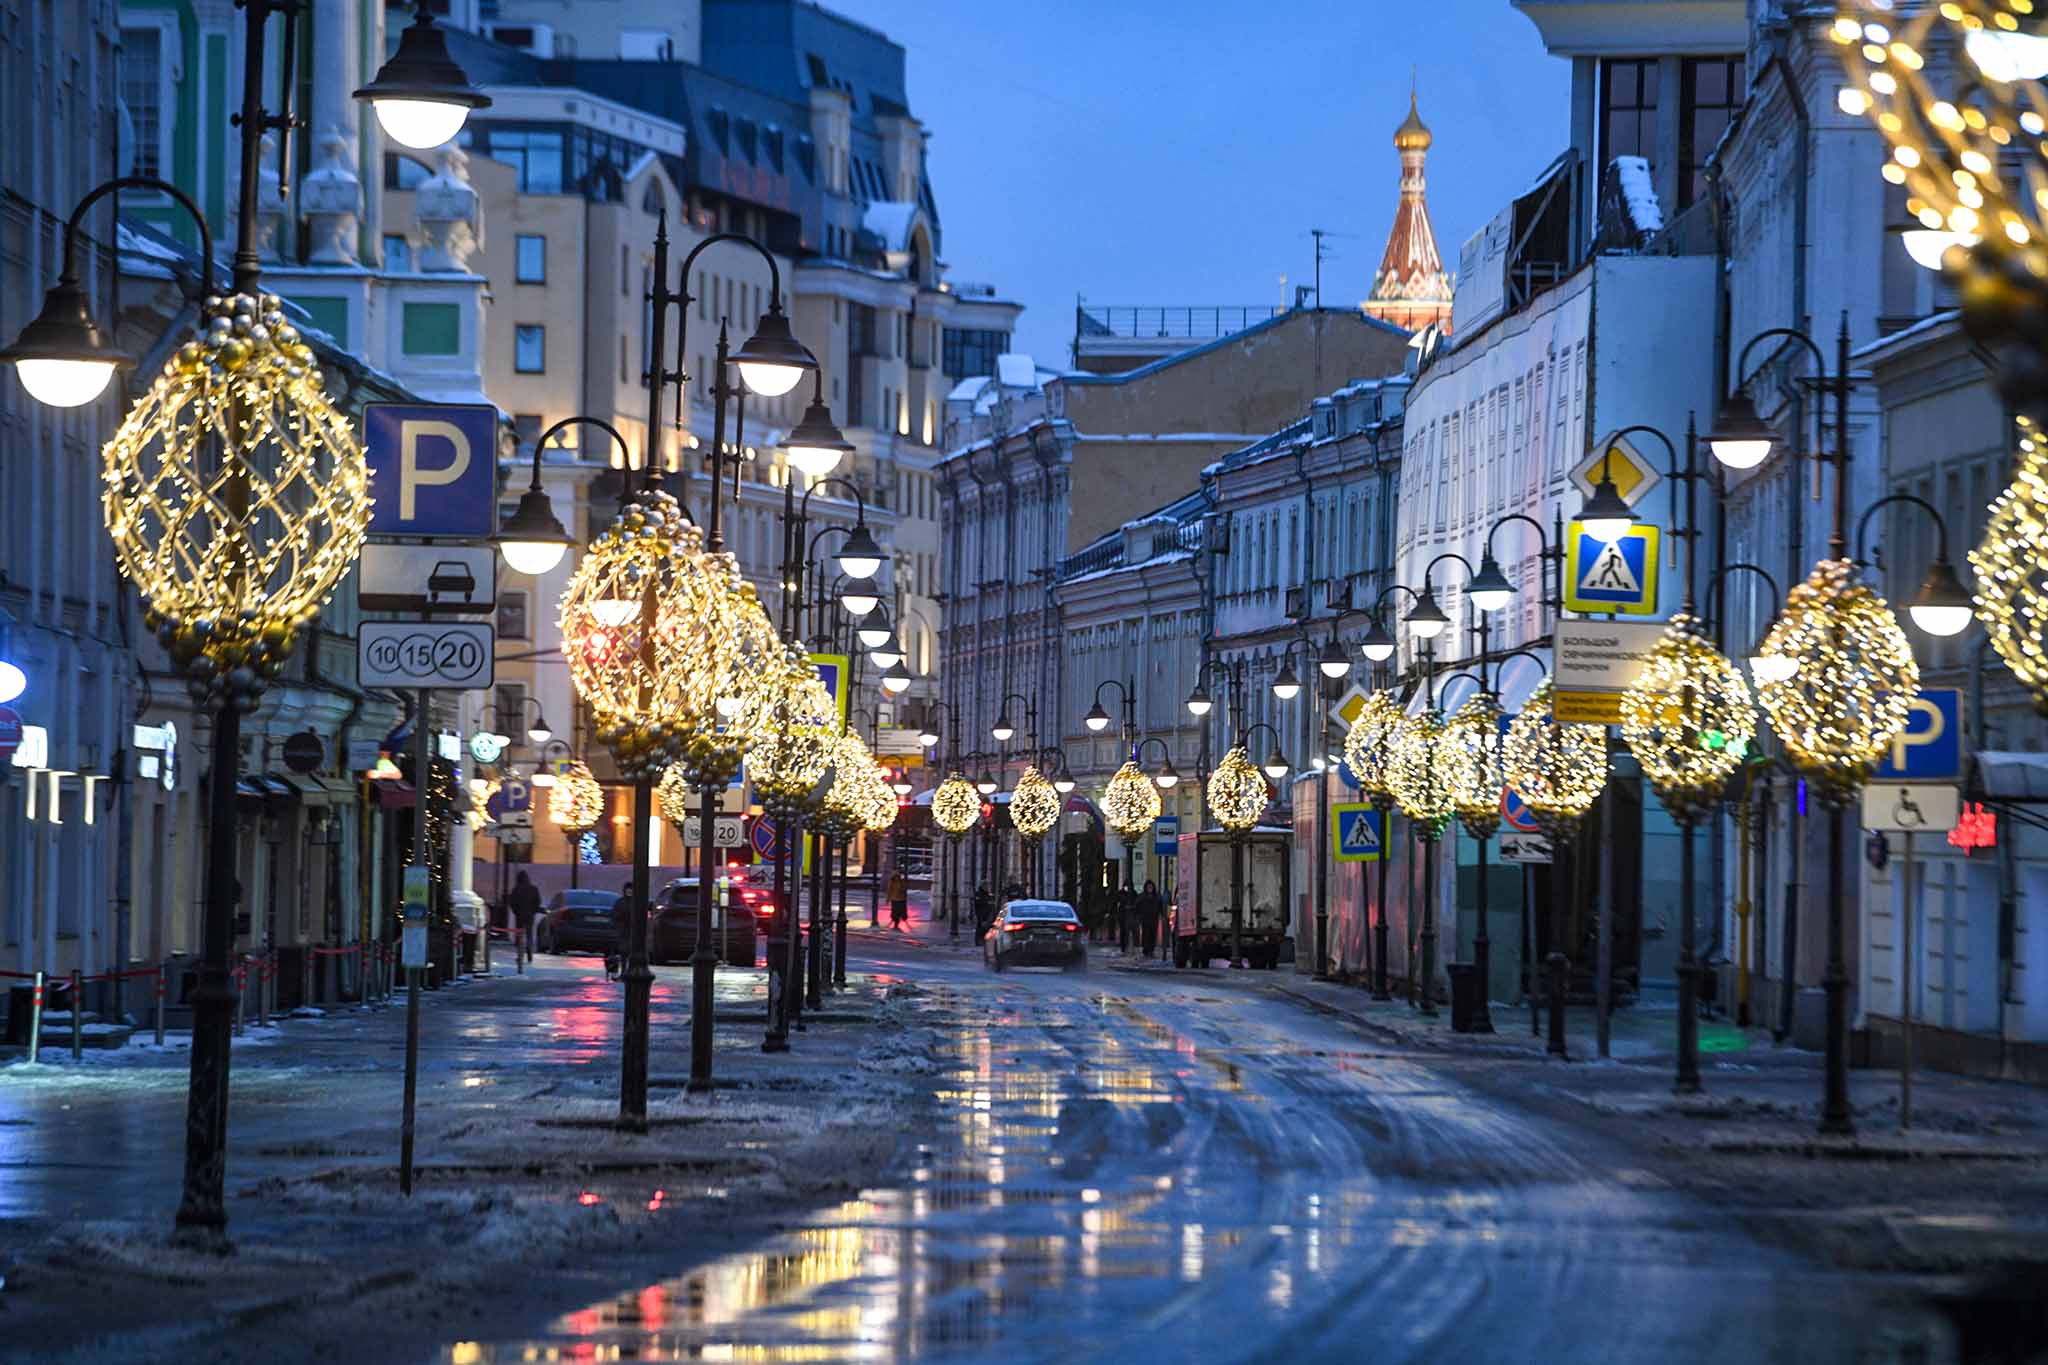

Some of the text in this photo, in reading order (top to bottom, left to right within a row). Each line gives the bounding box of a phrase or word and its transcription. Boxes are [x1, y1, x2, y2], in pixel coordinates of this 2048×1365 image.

[400, 419, 471, 521] P
[375, 641, 477, 669] 10 15 20
[1892, 698, 1945, 772] P
[718, 827, 736, 840] 20
